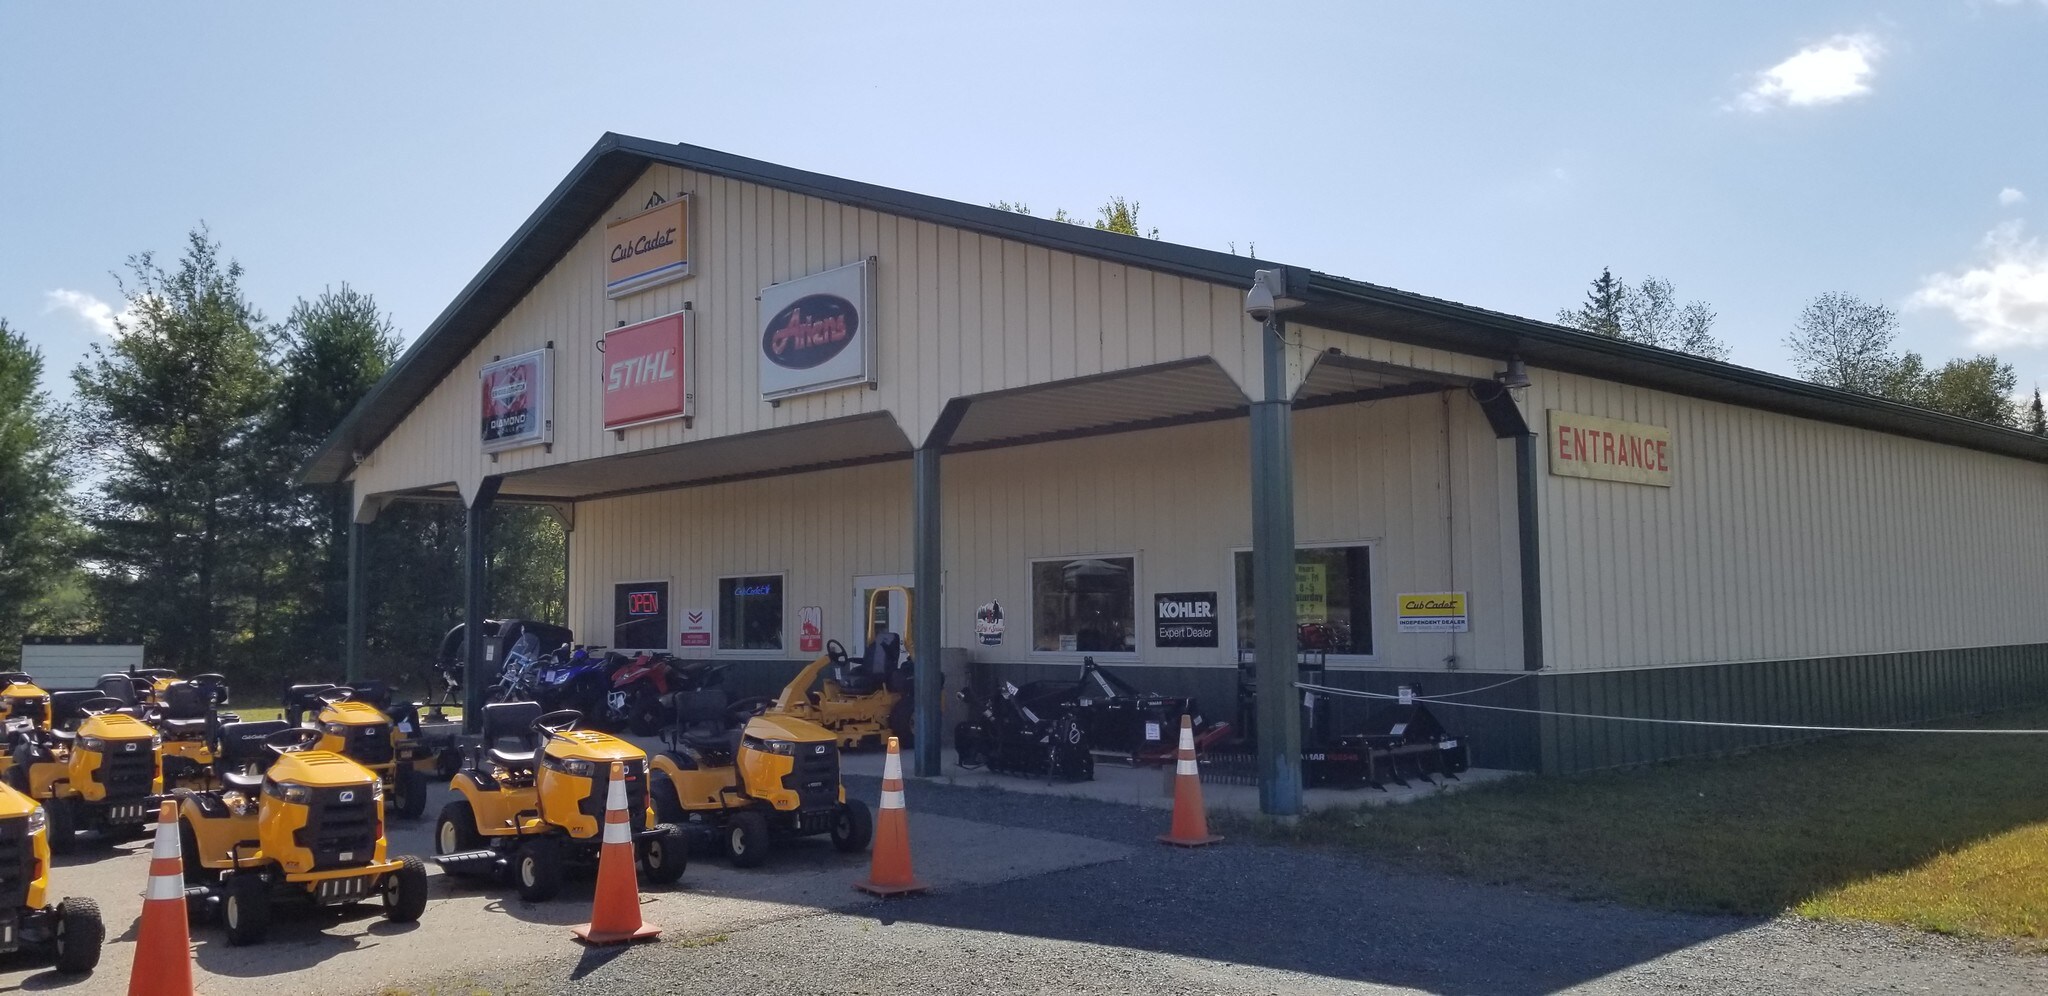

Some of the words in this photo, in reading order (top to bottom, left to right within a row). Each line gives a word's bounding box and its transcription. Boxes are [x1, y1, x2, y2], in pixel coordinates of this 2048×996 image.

[611, 240, 633, 263] Cub
[635, 227, 676, 255] Cadet
[772, 307, 846, 354] Ariens
[607, 349, 675, 392] STIHL
[491, 414, 525, 429] DIAMOND
[1559, 425, 1668, 471] ENTRANCE
[630, 593, 657, 612] OPEN
[1406, 600, 1424, 609] Cub
[1425, 600, 1457, 609] Cadet
[1160, 627, 1185, 640] Expert
[1187, 627, 1212, 638] Dealer
